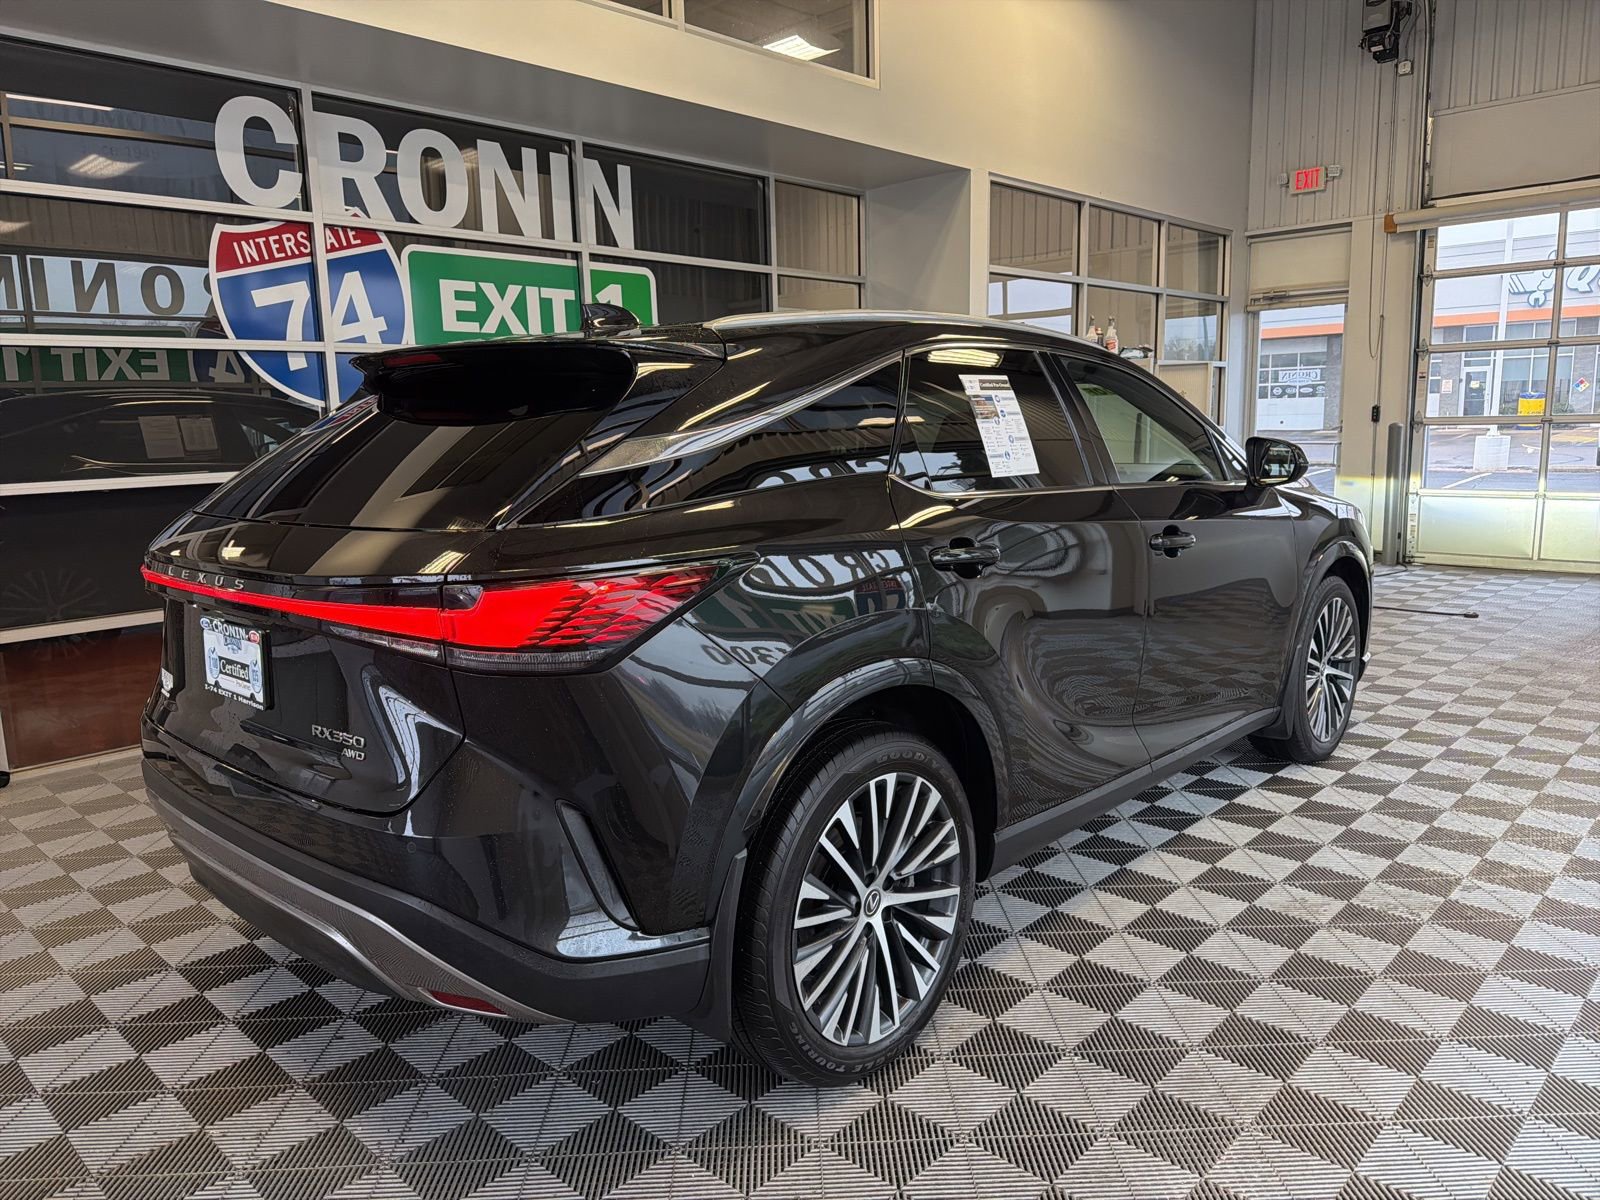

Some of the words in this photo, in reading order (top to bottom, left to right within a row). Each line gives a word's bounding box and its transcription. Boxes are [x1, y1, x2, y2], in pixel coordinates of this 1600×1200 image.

[214, 96, 634, 250] CRONIN
[1295, 167, 1320, 190] EXIT
[233, 227, 361, 264] INTERSATE
[439, 278, 576, 335] EXIT
[251, 270, 388, 371] 74
[168, 566, 244, 589] LEXUS
[212, 620, 246, 641] CRONIN
[220, 659, 249, 680] Certified
[218, 688, 232, 698] EXIT
[238, 695, 264, 711] Harrison
[311, 724, 365, 748] RX350
[341, 747, 365, 760] AWD
[789, 1022, 847, 1073] TOURING
